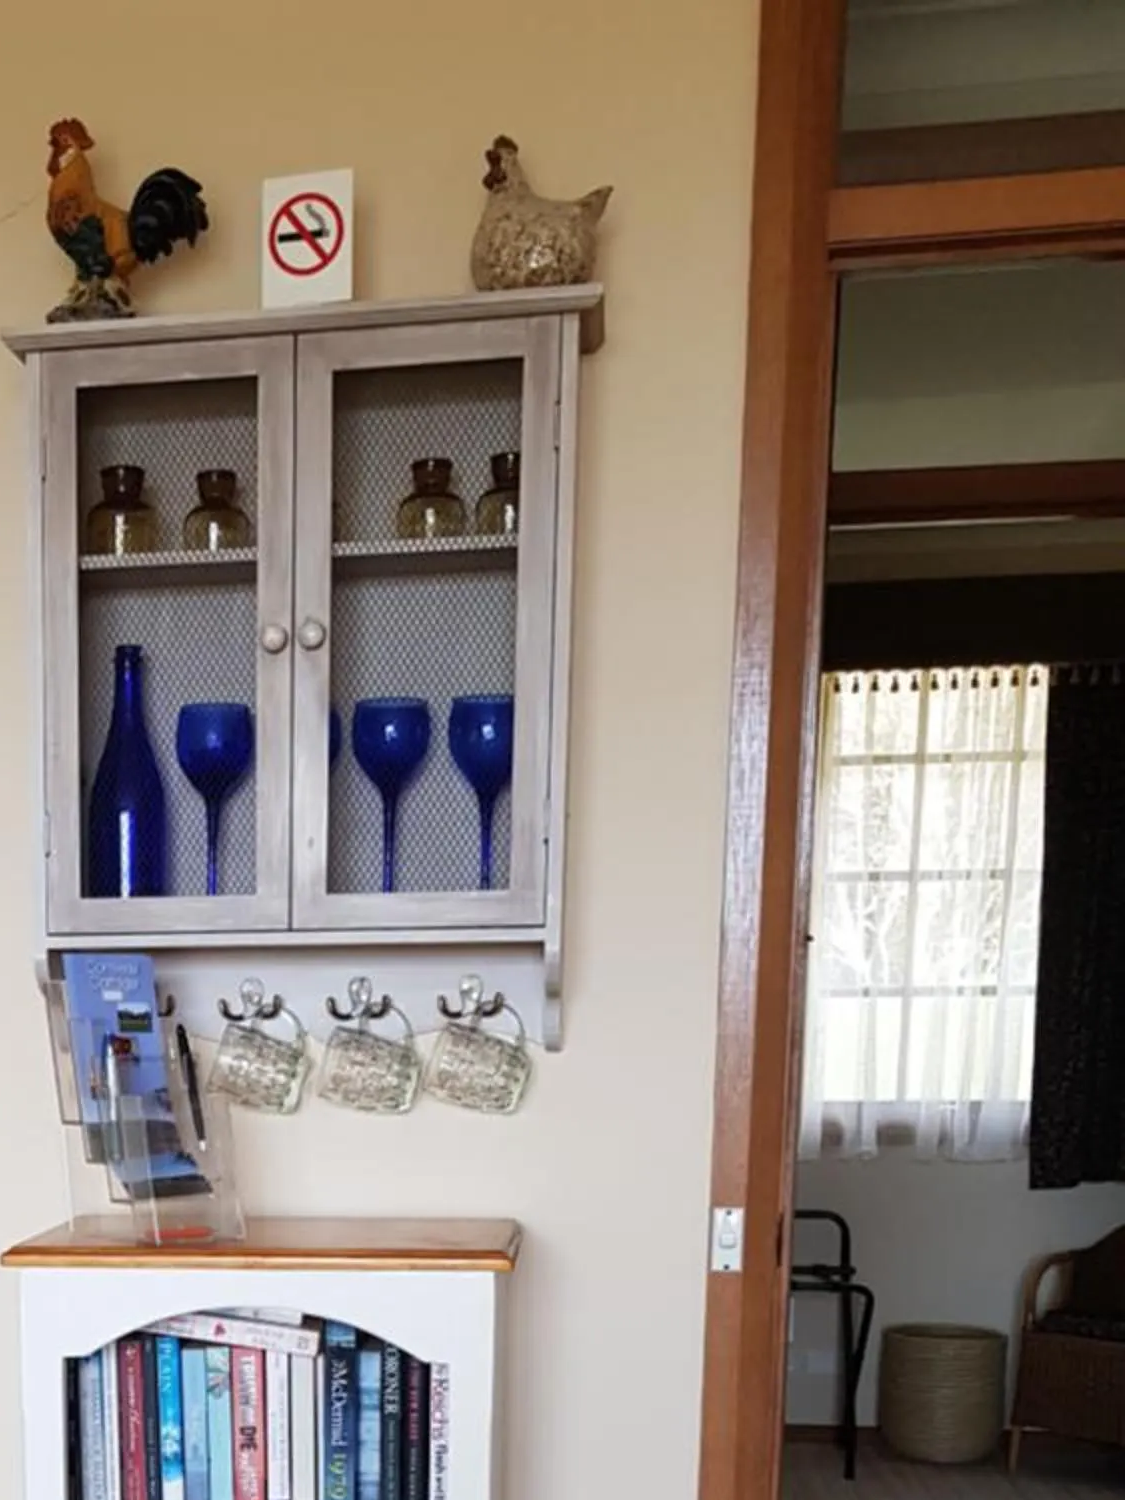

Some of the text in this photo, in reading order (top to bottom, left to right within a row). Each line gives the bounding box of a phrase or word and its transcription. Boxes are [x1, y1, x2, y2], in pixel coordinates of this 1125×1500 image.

[330, 1366, 350, 1446] McDermid
[383, 1345, 400, 1414] ORONER
[239, 1425, 258, 1452] DIE
[328, 1452, 348, 1500] 1979
